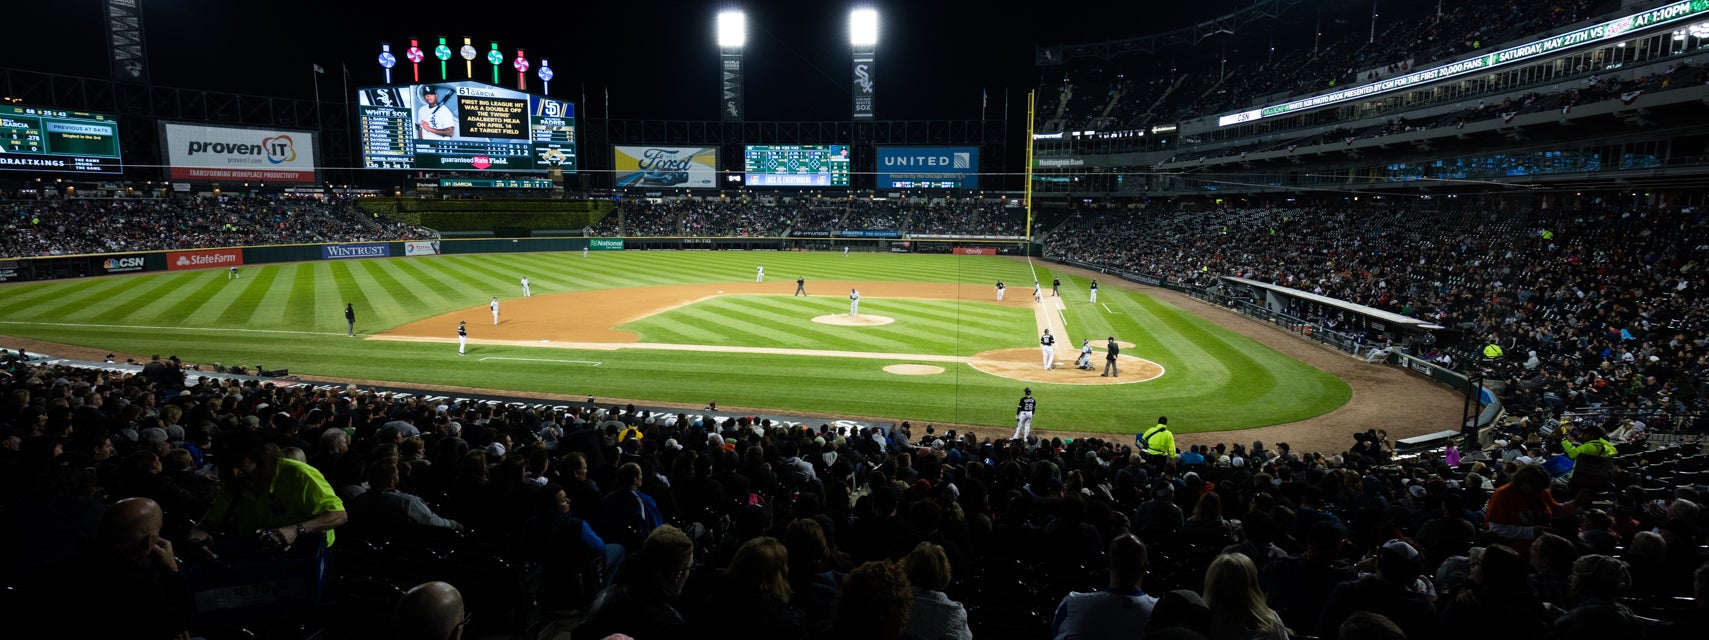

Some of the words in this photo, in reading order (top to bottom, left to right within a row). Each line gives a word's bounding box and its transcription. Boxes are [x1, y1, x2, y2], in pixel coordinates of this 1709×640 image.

[1499, 45, 1542, 61] SATURDAY,
[1544, 38, 1562, 51] MAY
[1564, 31, 1588, 45] 27TH
[1590, 26, 1603, 38] VS
[1635, 13, 1651, 27] AT
[1652, 2, 1691, 22] 1:10PM
[1344, 84, 1374, 98] PRESENTED
[1374, 83, 1382, 91] BY
[1382, 80, 1394, 89] CSN
[1394, 78, 1407, 87] FOR
[1407, 75, 1420, 84] THE
[1420, 70, 1439, 81] FIRST
[1439, 64, 1462, 77] 20,000
[1463, 60, 1483, 71] FANS
[459, 87, 470, 95] 61
[1238, 113, 1250, 122] CSN
[540, 119, 566, 127] PADRES
[187, 140, 262, 156] proven
[271, 143, 288, 156] IT
[0, 158, 65, 167] DRAFTKINGS
[474, 156, 488, 164] Rate
[638, 148, 693, 172] Ford
[884, 156, 949, 166] UNITED
[1039, 159, 1070, 168] Huntington
[189, 169, 231, 178] TRANSFORMING
[232, 171, 262, 179] WORKPLACE
[264, 172, 299, 180] PRODUCTIVITY
[327, 246, 385, 256] WINTRUST
[119, 257, 145, 267] CSN
